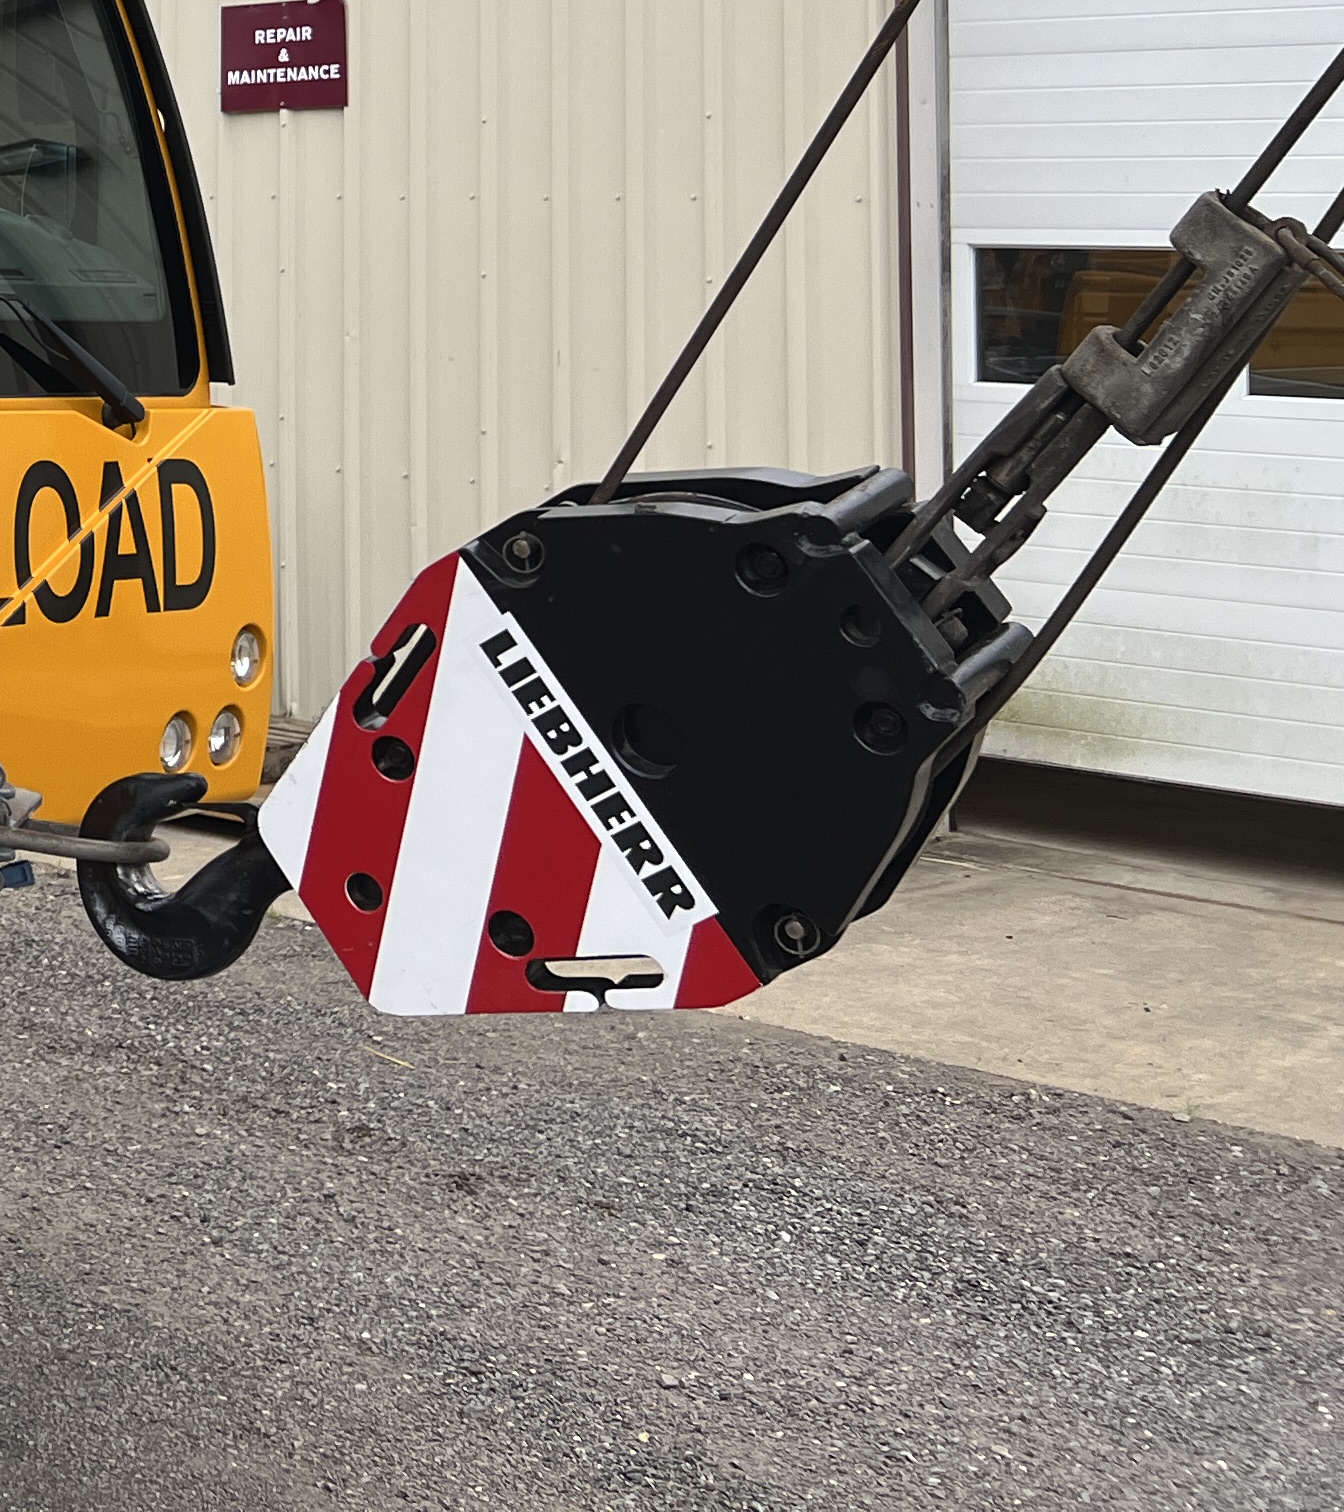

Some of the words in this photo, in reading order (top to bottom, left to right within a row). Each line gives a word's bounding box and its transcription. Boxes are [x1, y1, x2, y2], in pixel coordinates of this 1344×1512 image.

[254, 26, 313, 45] REPAIR
[277, 47, 290, 63] &
[227, 63, 341, 86] MAINTENANCE
[479, 628, 697, 923] LIEBHERR
